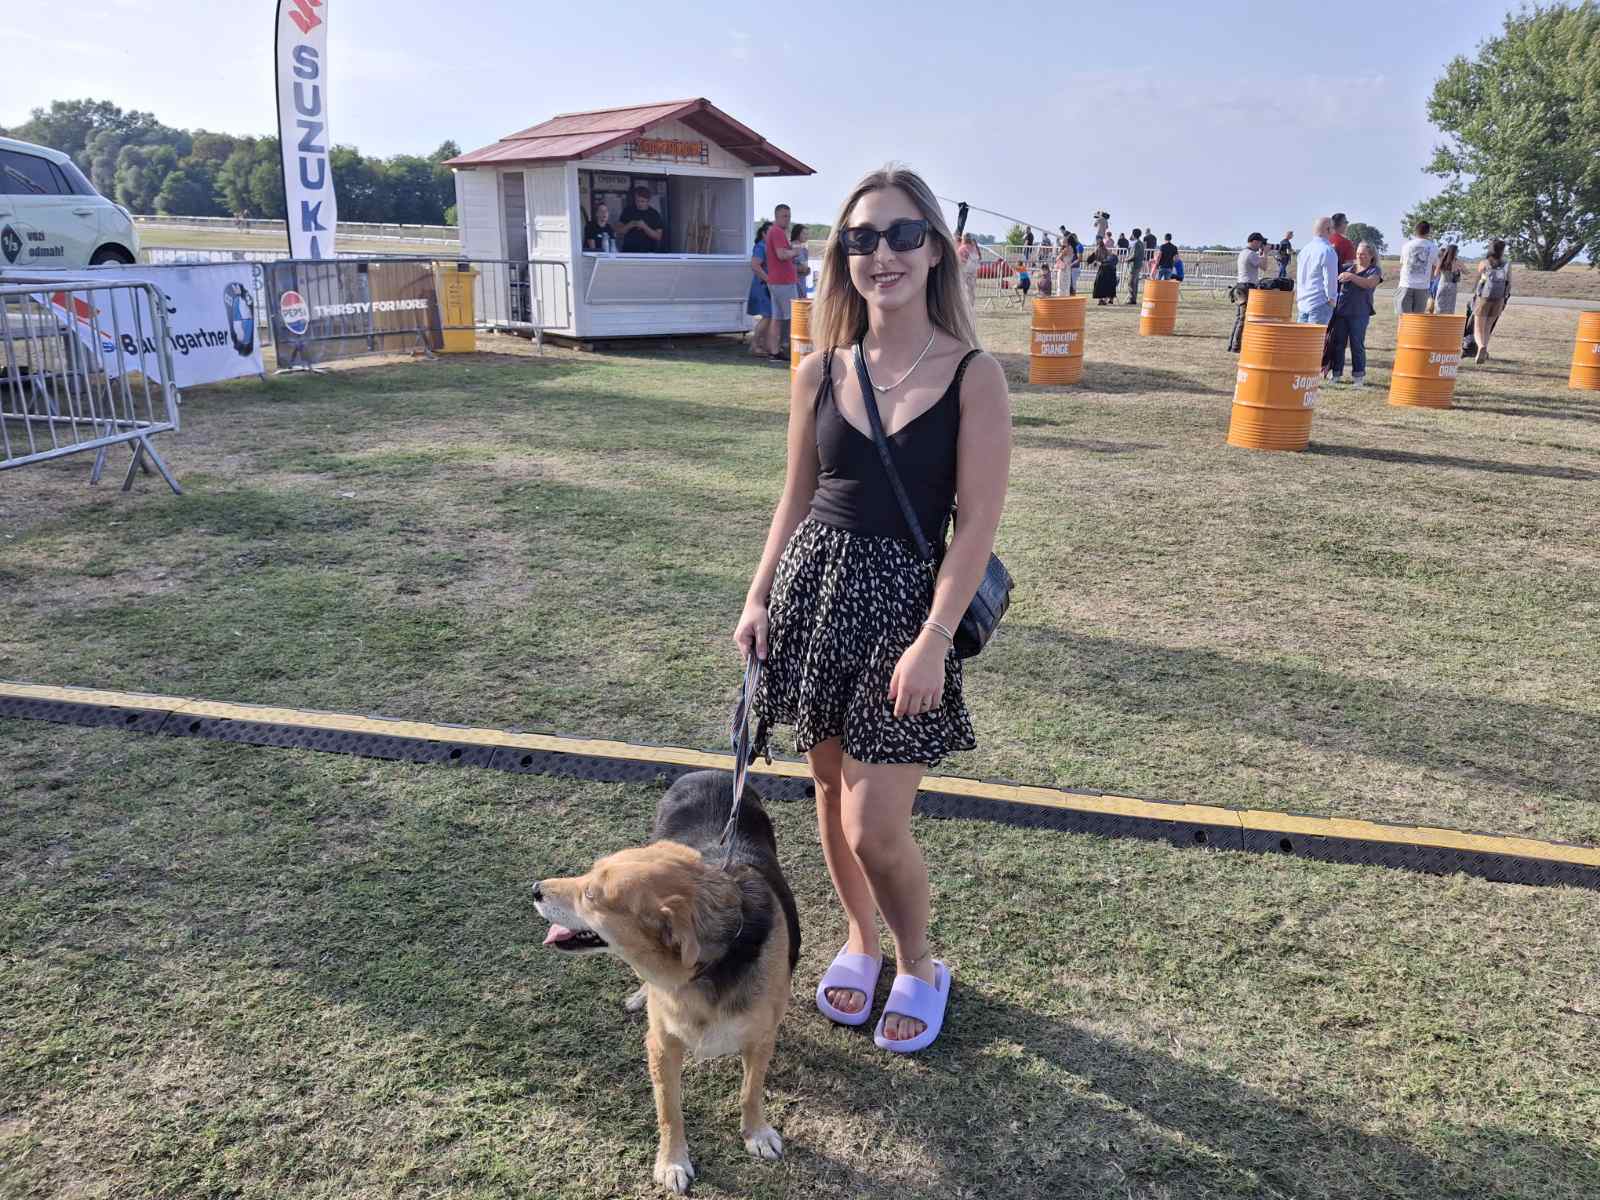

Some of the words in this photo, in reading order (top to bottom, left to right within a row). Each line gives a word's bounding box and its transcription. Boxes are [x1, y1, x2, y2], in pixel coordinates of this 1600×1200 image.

[292, 44, 328, 260] SUZUKI
[313, 302, 370, 317] THIRSTY
[372, 300, 396, 312] FOR
[396, 298, 429, 311] MORE
[1041, 343, 1069, 354] ORANGE
